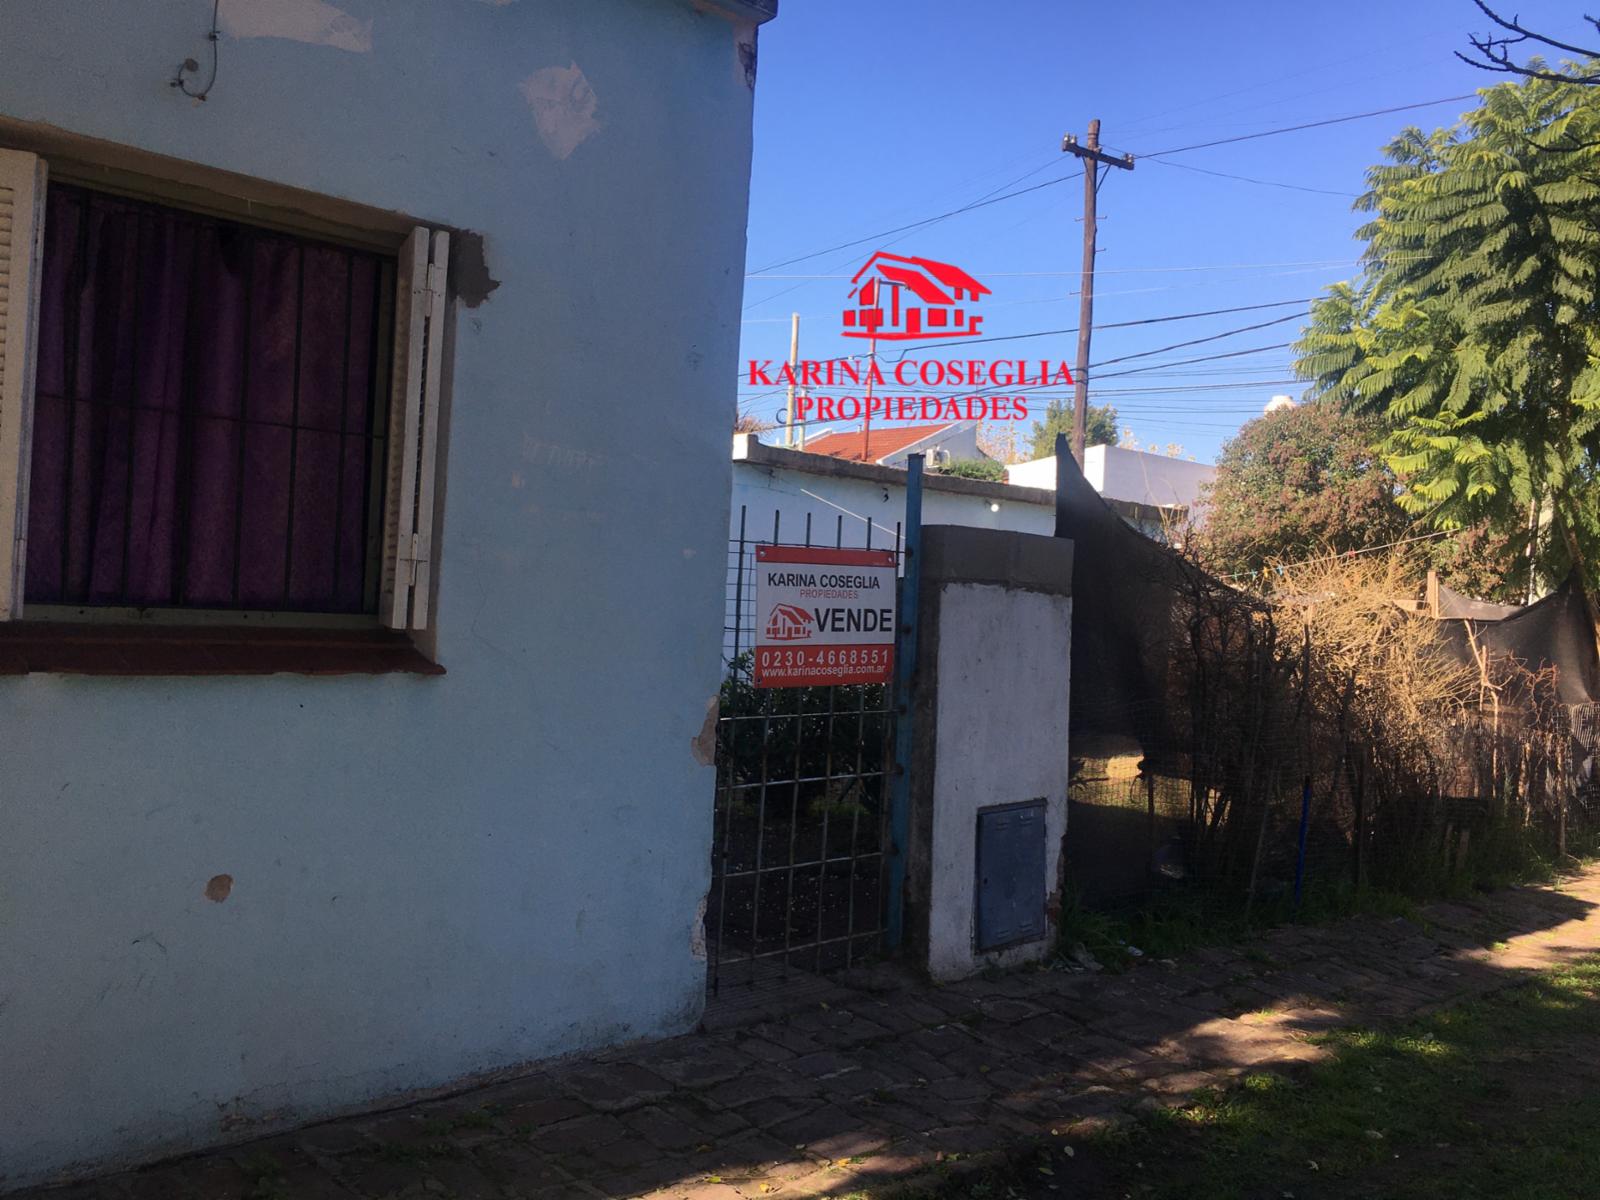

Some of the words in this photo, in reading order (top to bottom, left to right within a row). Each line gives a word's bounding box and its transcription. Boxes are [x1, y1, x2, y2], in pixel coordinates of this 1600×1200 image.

[768, 573, 817, 587] KARINA
[820, 574, 880, 589] COSEGLIA
[800, 589, 859, 599] PROPIEDADES
[814, 608, 892, 632] VENDE
[761, 663, 885, 678] www.karinacoseglia.com.ar
